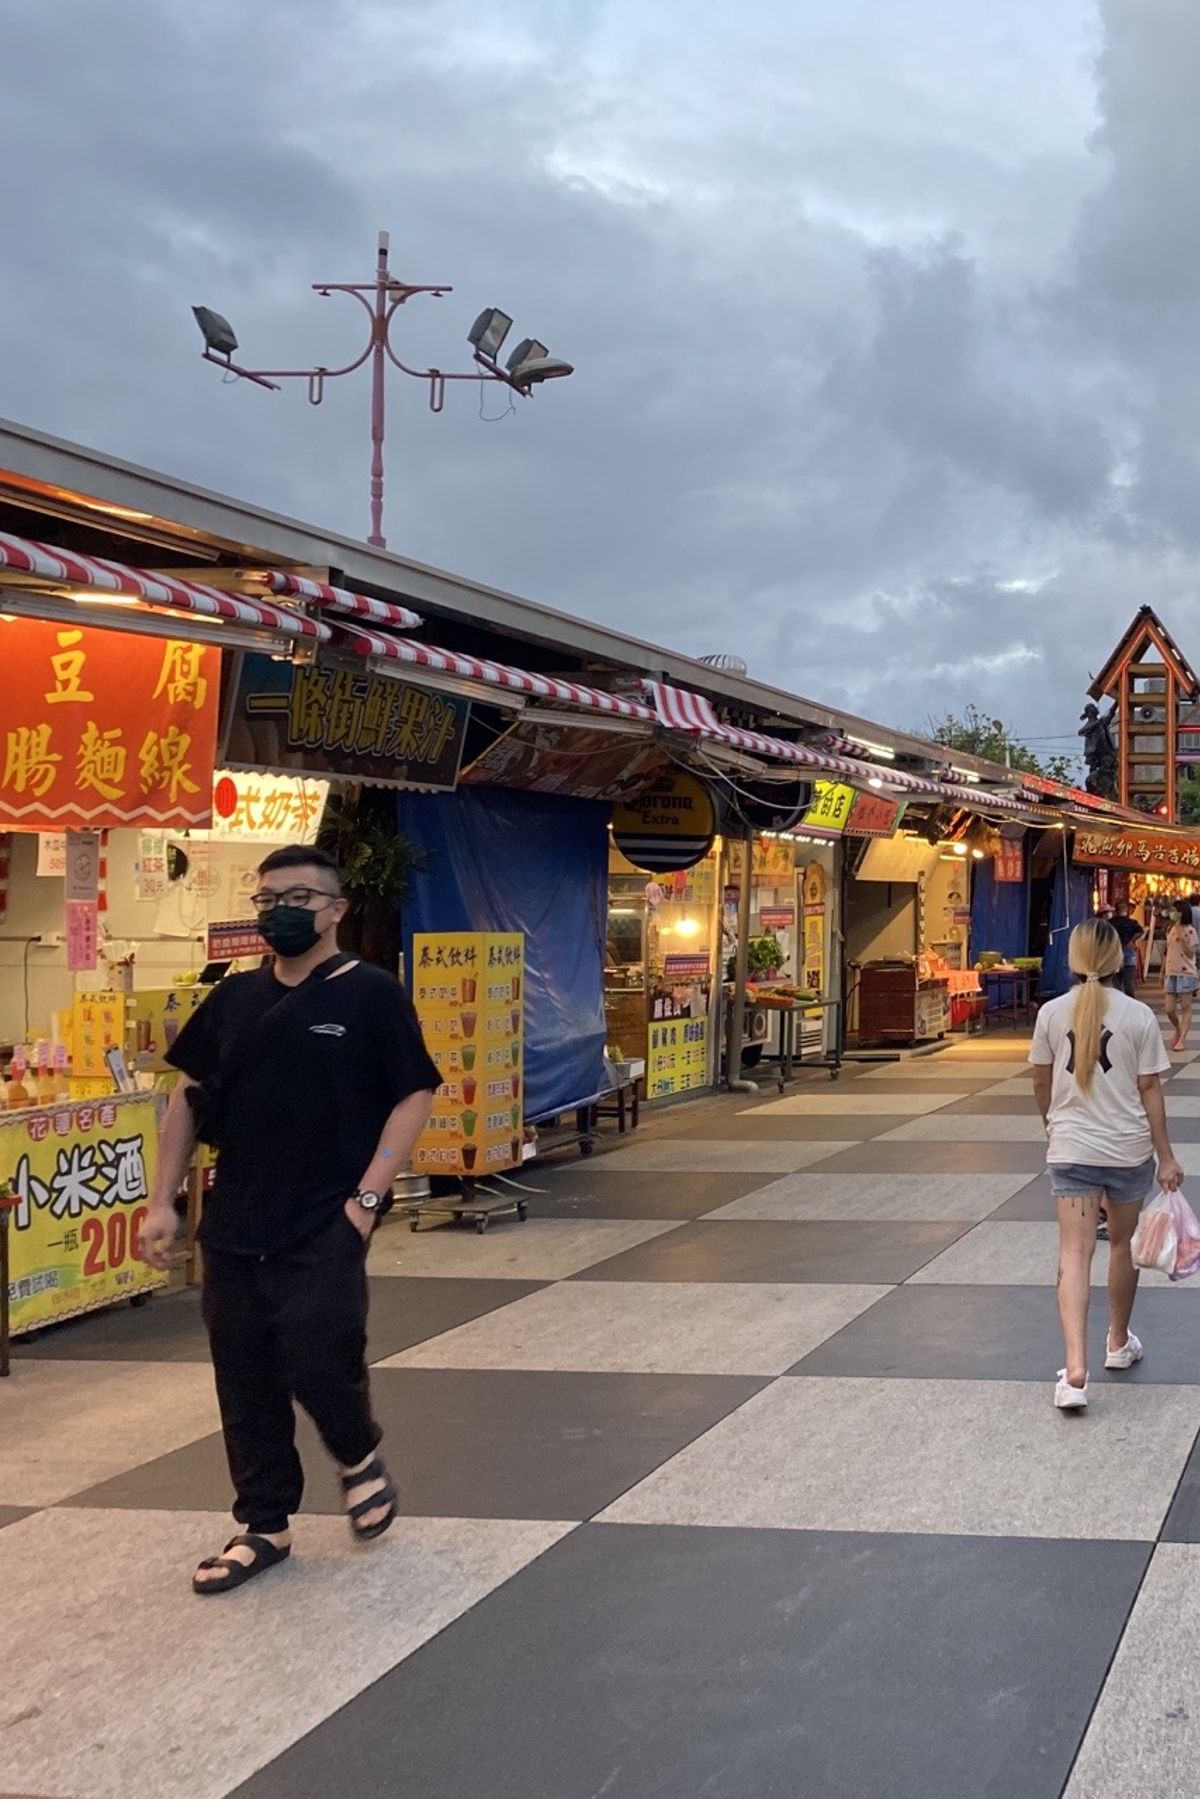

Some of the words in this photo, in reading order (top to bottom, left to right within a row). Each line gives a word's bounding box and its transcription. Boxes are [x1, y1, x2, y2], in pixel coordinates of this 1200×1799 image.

[0, 720, 202, 803] 腸麵線
[641, 809, 680, 825] Extra
[419, 946, 477, 968] 泰式飲料
[487, 945, 521, 968] 泰式飲料
[29, 1104, 117, 1140] 花蓮名產
[15, 1133, 148, 1231] 小米酒
[47, 1228, 79, 1252] 一瓶
